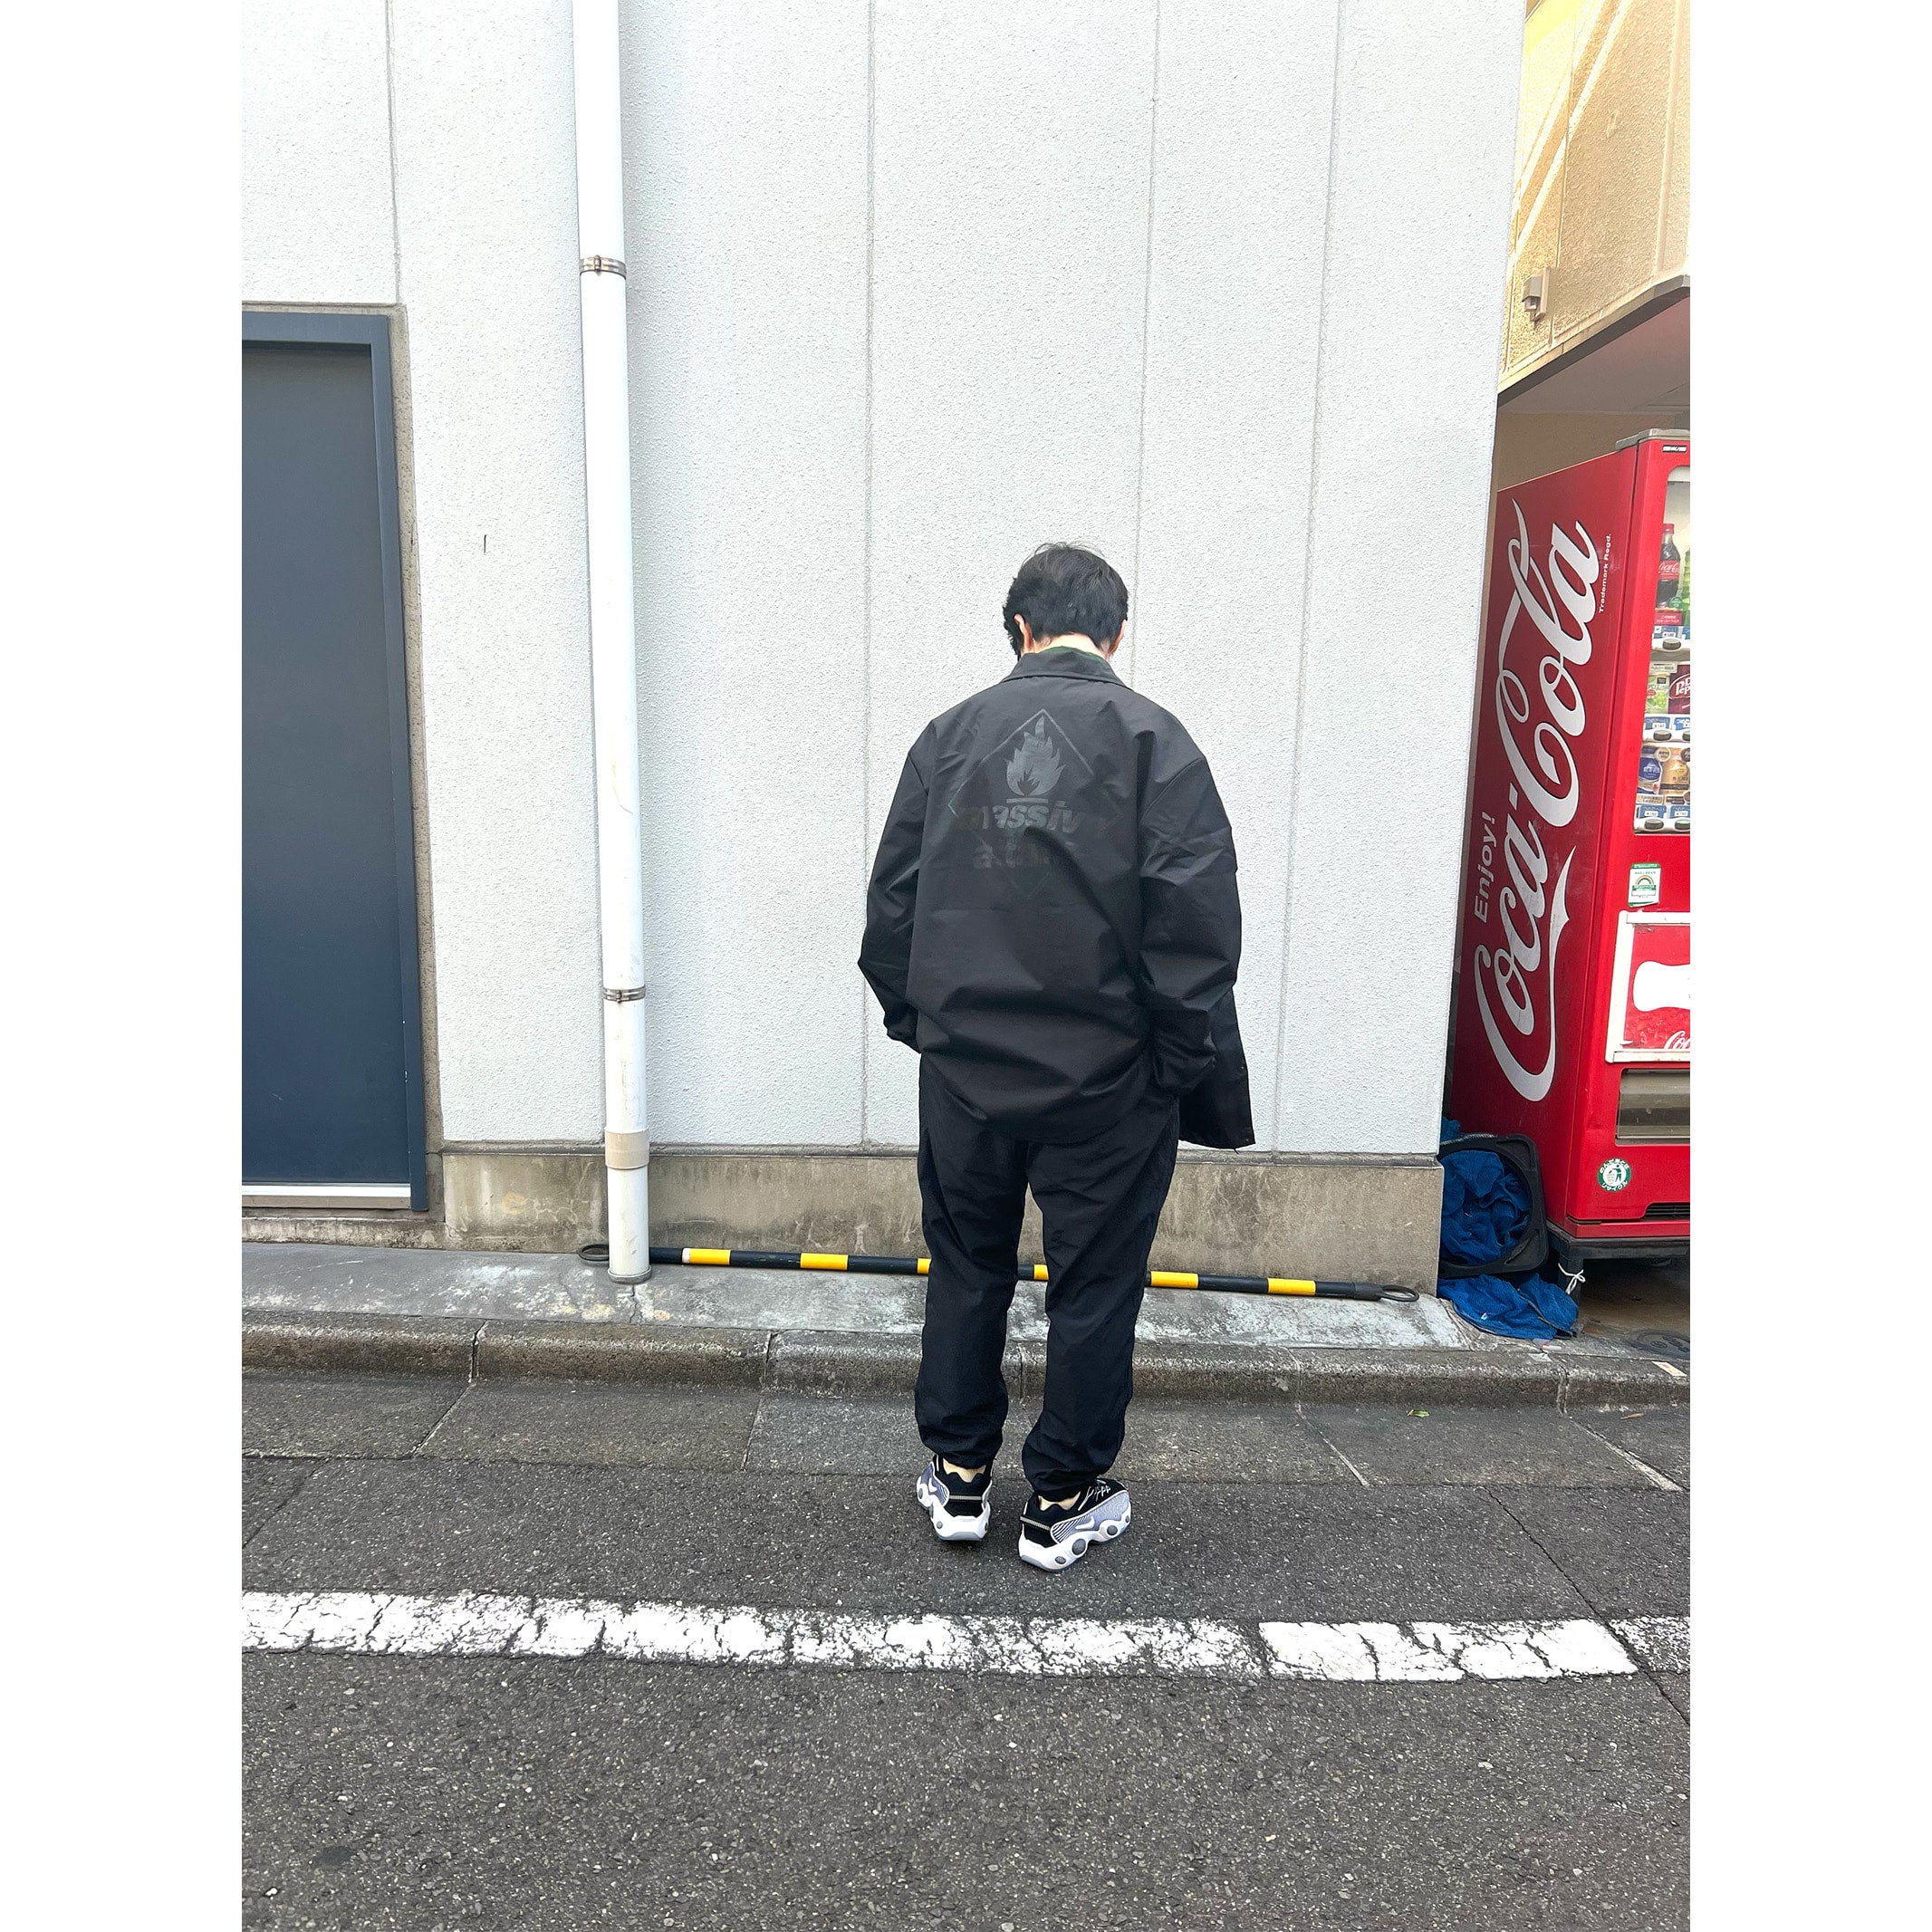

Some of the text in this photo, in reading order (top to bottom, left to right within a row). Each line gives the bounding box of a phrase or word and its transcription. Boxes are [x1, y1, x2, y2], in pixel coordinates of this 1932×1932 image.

[1599, 533, 1611, 614] Trademark Regd.
[956, 801, 1091, 833] assiv
[1475, 499, 1600, 1102] Coca-Cola
[1475, 812, 1497, 924] Enjoy!
